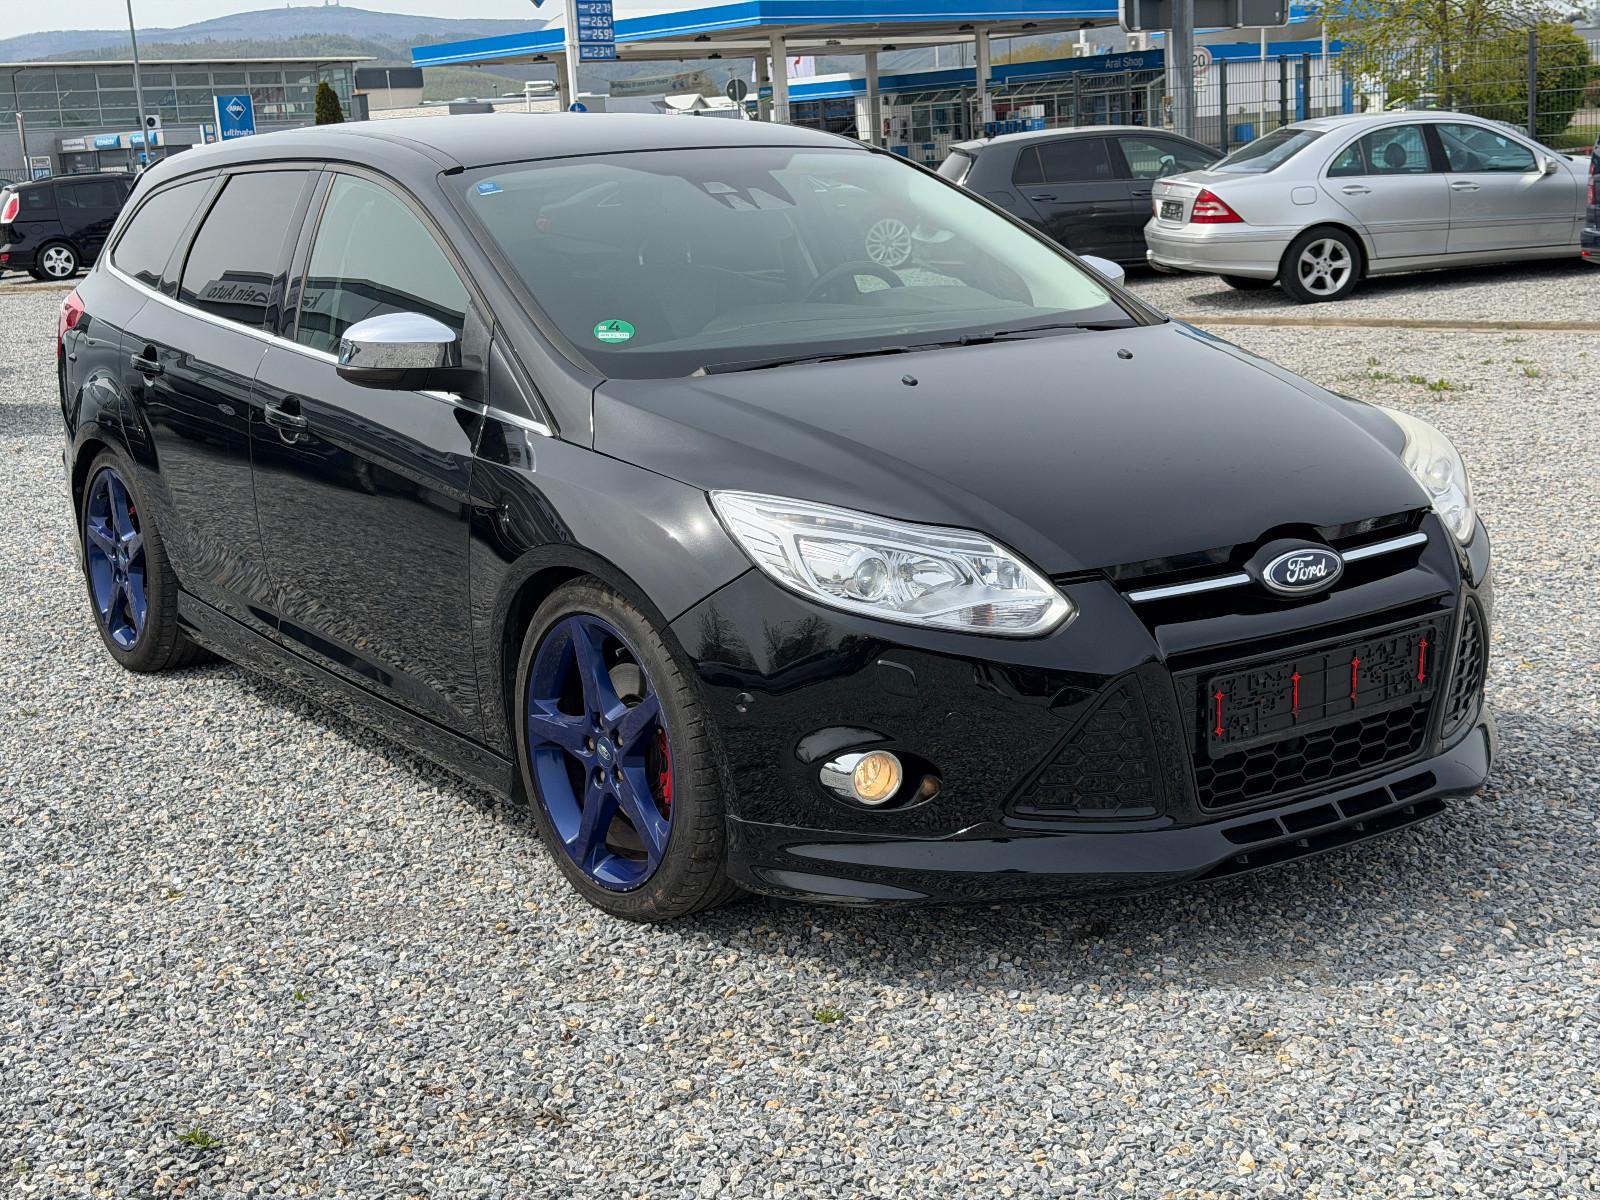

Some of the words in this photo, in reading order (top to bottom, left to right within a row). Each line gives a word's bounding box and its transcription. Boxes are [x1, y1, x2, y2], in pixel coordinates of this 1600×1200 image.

[1122, 56, 1144, 68] Shop
[608, 321, 620, 331] 4
[1286, 555, 1328, 583] Ford
